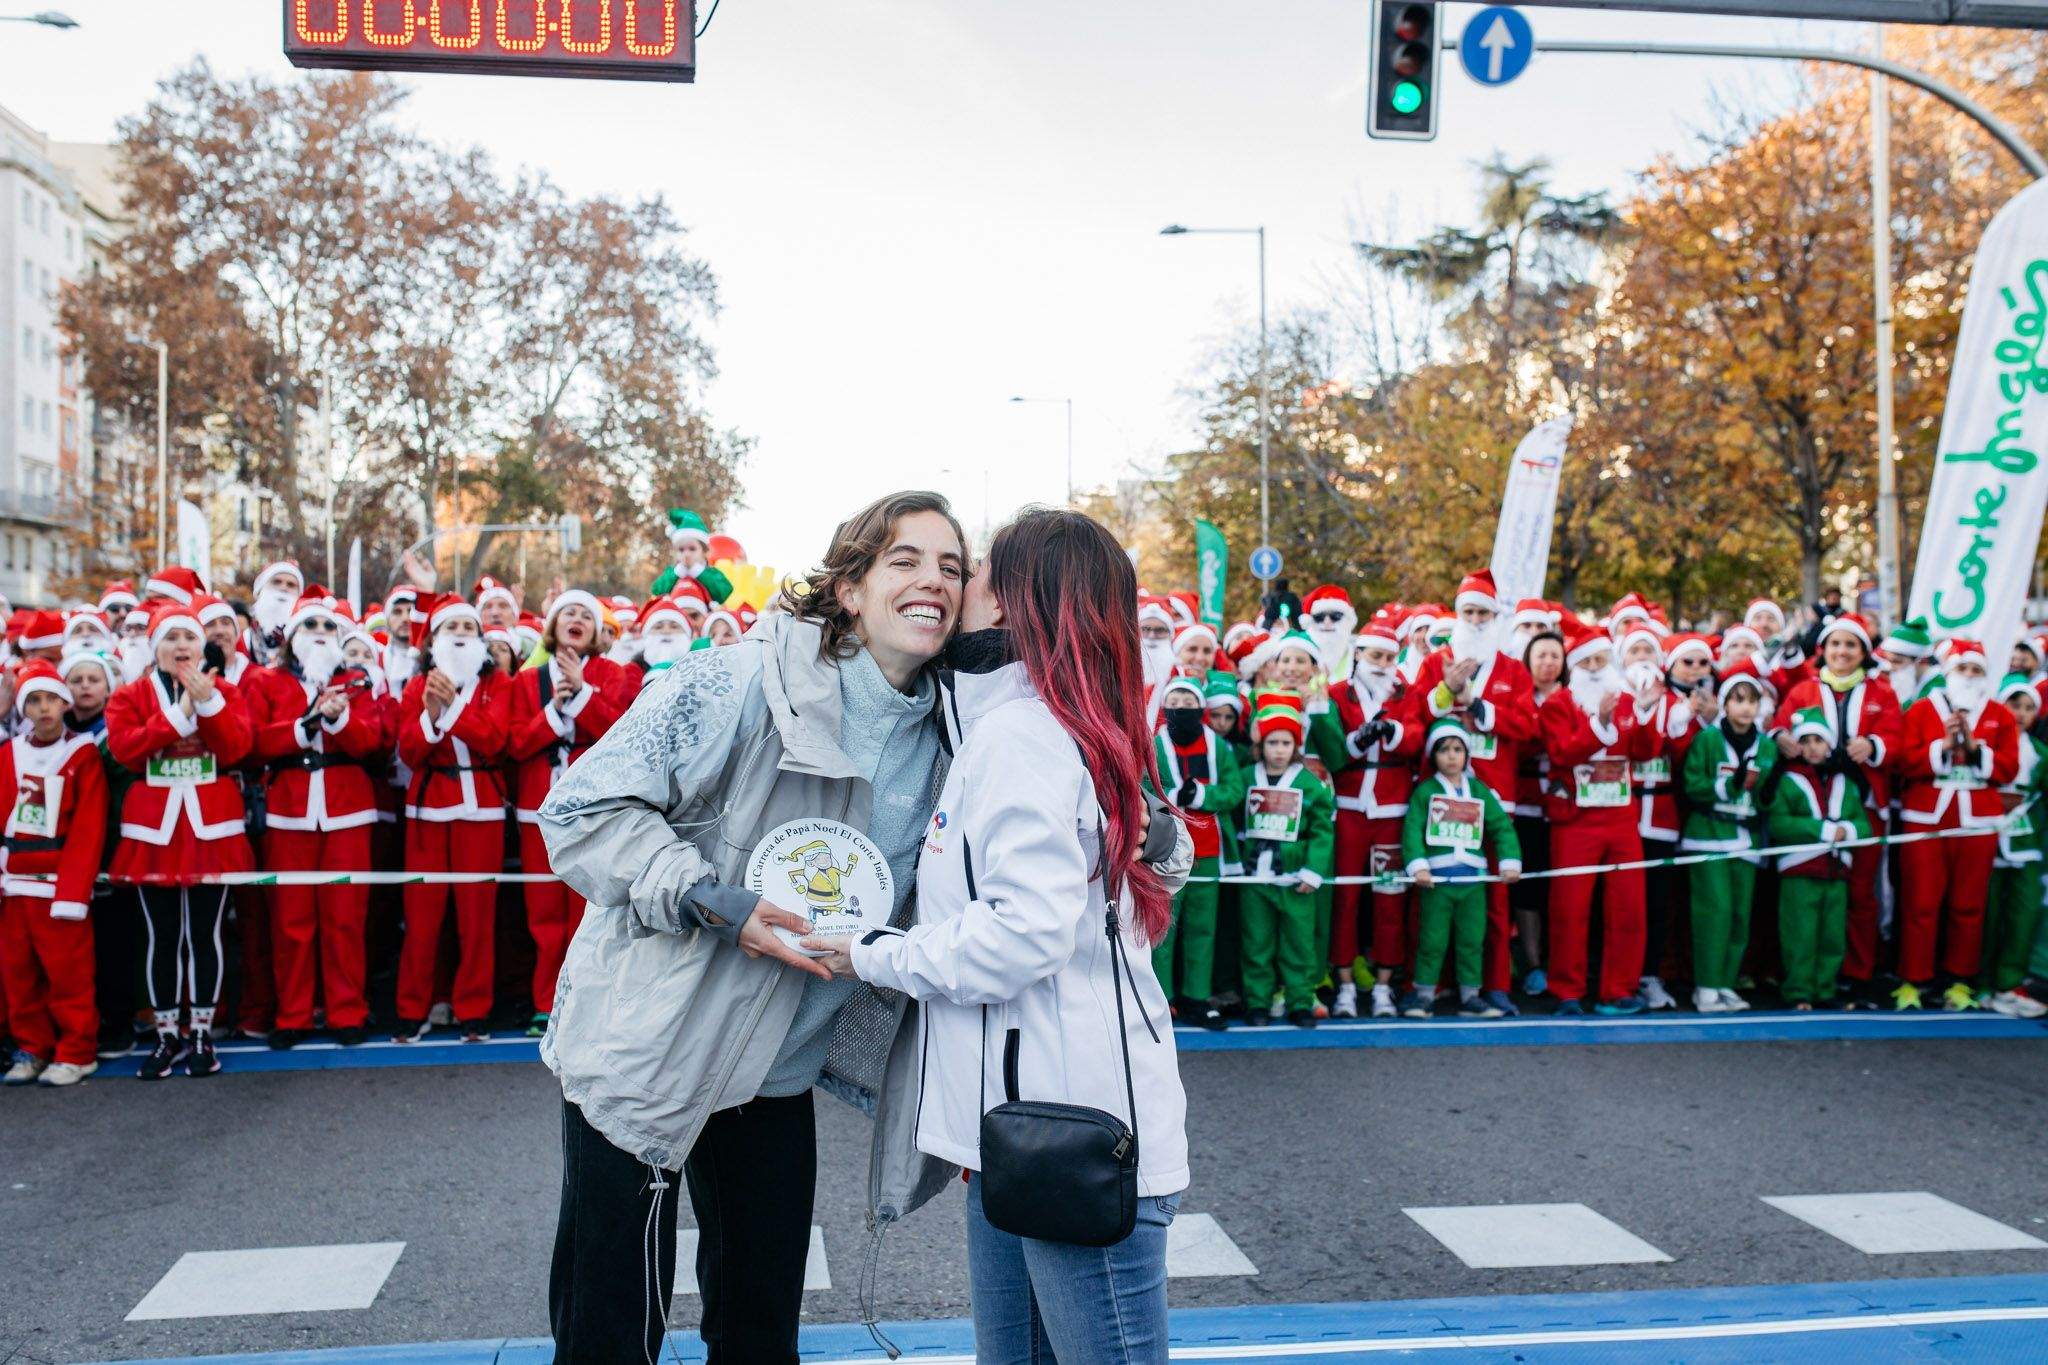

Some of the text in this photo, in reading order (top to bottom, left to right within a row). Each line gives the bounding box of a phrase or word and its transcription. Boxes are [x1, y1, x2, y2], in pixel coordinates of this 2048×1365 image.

[1933, 484, 2007, 629] Corte
[752, 844, 775, 877] Carrera
[774, 834, 785, 845] de
[785, 824, 810, 837] Papá
[813, 823, 838, 834] Noel
[840, 829, 852, 840] El
[853, 837, 876, 860] Corte
[873, 860, 888, 891] Inglés
